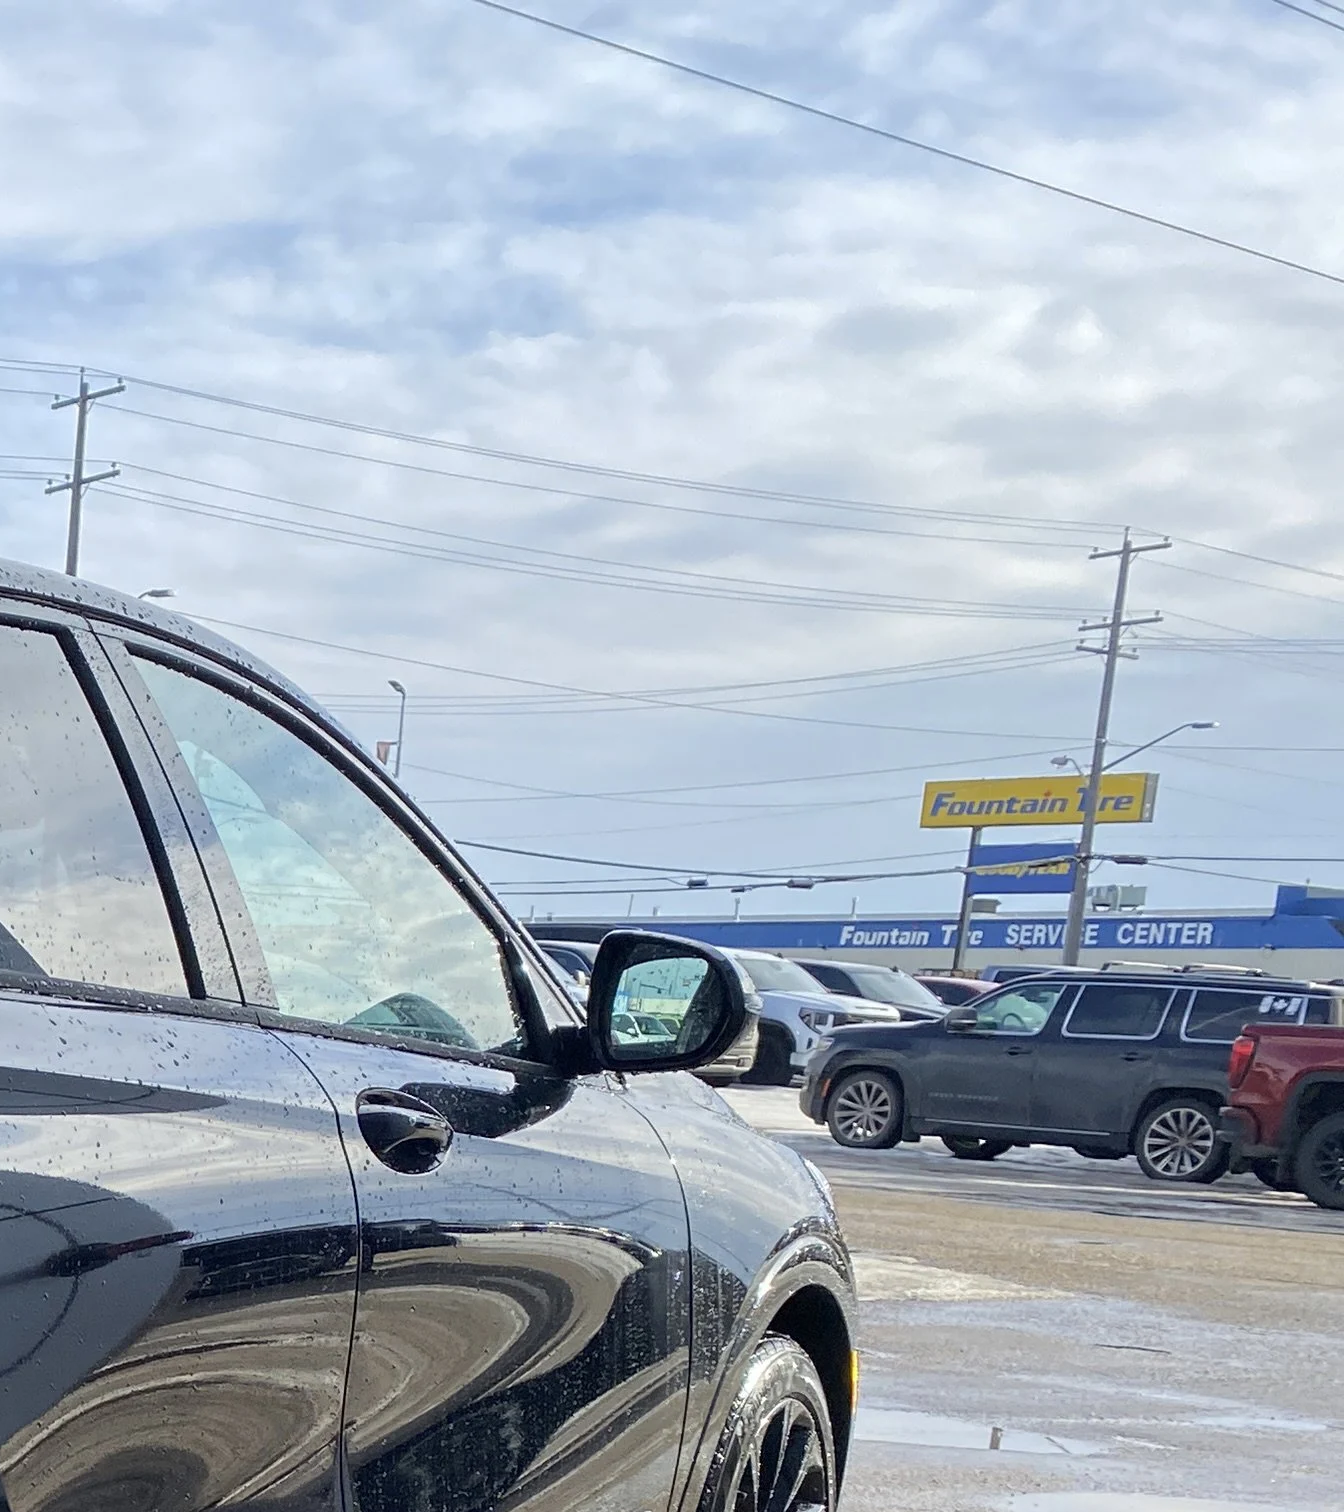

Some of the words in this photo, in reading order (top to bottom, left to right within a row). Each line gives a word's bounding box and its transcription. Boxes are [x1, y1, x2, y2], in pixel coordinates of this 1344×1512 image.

[930, 789, 1068, 817] Fountain
[1076, 787, 1134, 812] Tre
[839, 925, 930, 946] Fountain
[1117, 922, 1214, 945] CENTER
